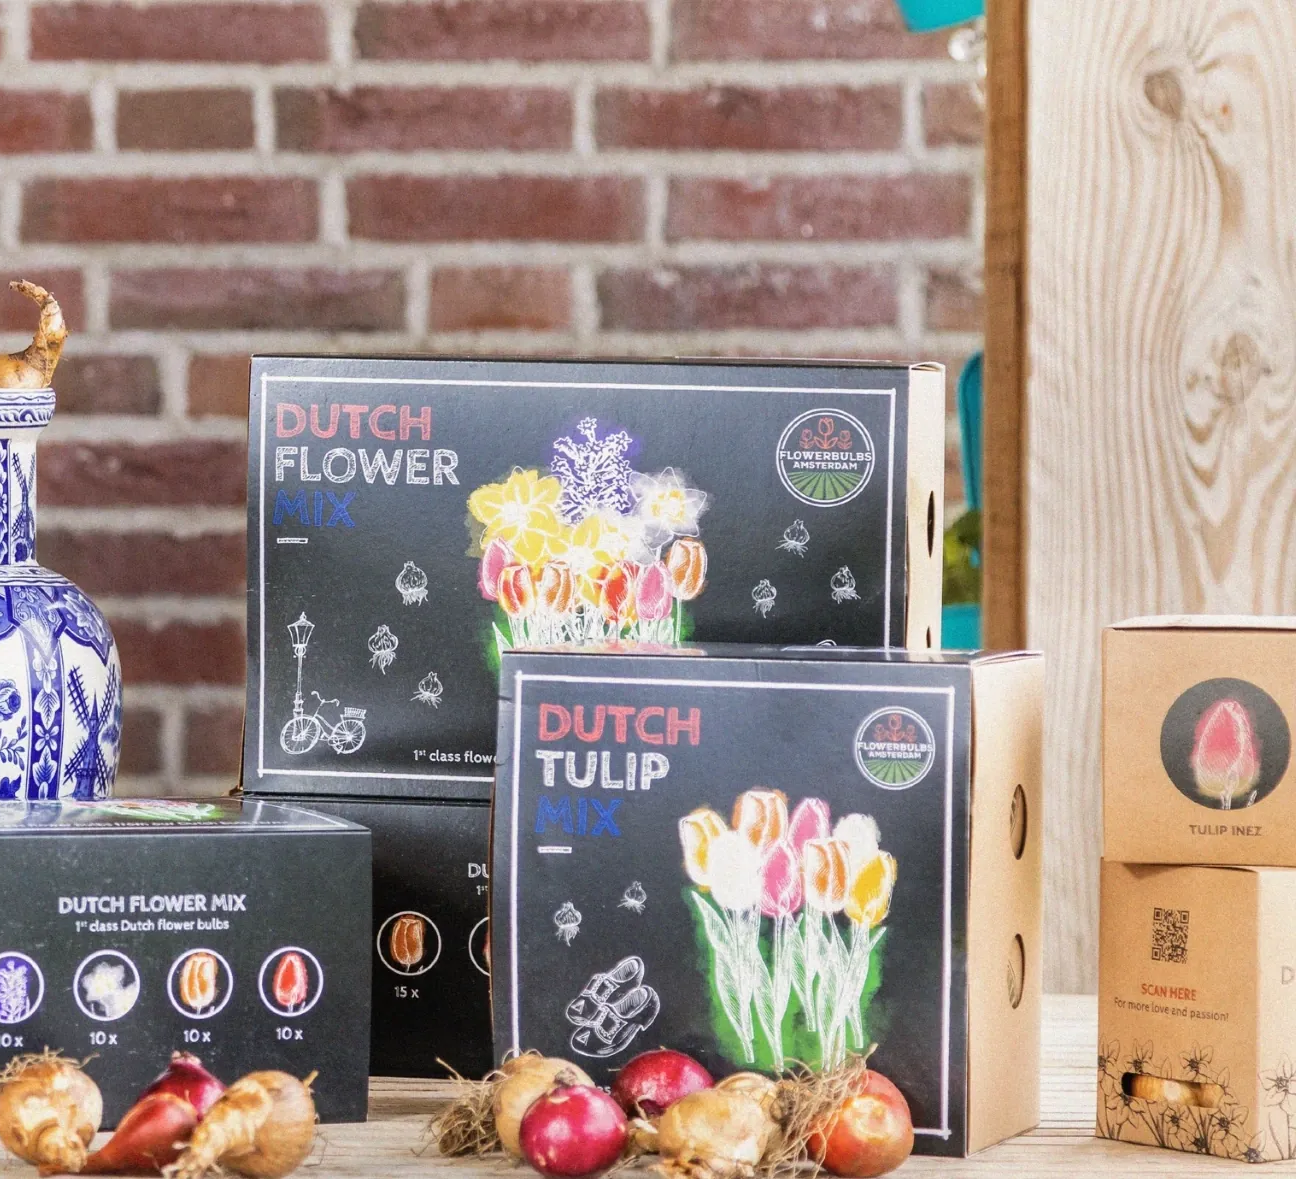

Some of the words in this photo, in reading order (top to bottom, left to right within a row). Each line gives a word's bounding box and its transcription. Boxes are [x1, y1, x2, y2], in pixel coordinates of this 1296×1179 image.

[276, 403, 432, 441] DUTCH
[780, 450, 872, 462] FLOWERBULBS
[275, 446, 460, 485] FLOWER
[793, 461, 857, 470] AMSTERDAM
[272, 489, 357, 528] MIX
[538, 703, 701, 746] DUTCH
[857, 741, 933, 753] FLOWERBULBS
[413, 749, 426, 761] 1st
[429, 749, 461, 762] class
[869, 751, 921, 759] AMSTERDAM
[535, 749, 670, 791] TULIP
[535, 795, 624, 837] MIX
[1189, 824, 1228, 836] TULIP
[1232, 825, 1263, 836] INEZ
[58, 896, 125, 914] DUTCH
[129, 894, 206, 913] FLOWER
[211, 894, 247, 912] MIX
[75, 920, 88, 932] 1st
[89, 919, 118, 932] class
[121, 919, 154, 932] Dutch
[157, 918, 194, 932] flower
[196, 918, 230, 930] bulbs
[394, 986, 408, 998] 15
[411, 988, 420, 999] x
[1141, 983, 1167, 998] SCAN
[1169, 987, 1197, 1001] HERE
[1114, 997, 1126, 1009] For
[1128, 1001, 1150, 1012] more
[1151, 1002, 1169, 1014] love
[1171, 1007, 1188, 1017] and
[89, 1031, 107, 1045] 10
[108, 1033, 118, 1045] x
[183, 1028, 200, 1042] 10
[202, 1031, 211, 1042] x
[276, 1026, 292, 1040] 10
[294, 1028, 304, 1040] x
[14, 1035, 24, 1047] x
